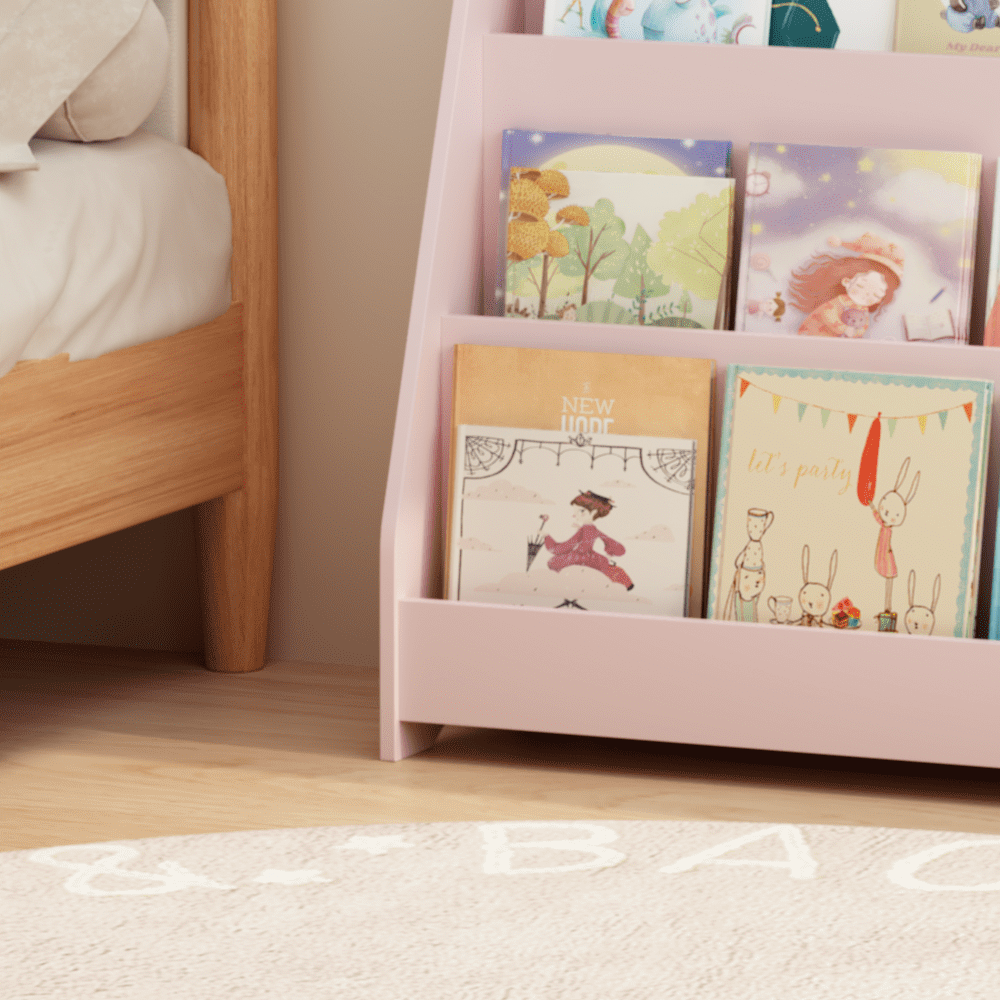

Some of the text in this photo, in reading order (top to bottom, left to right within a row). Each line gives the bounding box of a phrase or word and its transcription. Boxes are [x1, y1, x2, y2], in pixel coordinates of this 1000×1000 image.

[946, 42, 967, 53] My
[561, 396, 616, 416] NEW
[748, 447, 853, 496] let's party
